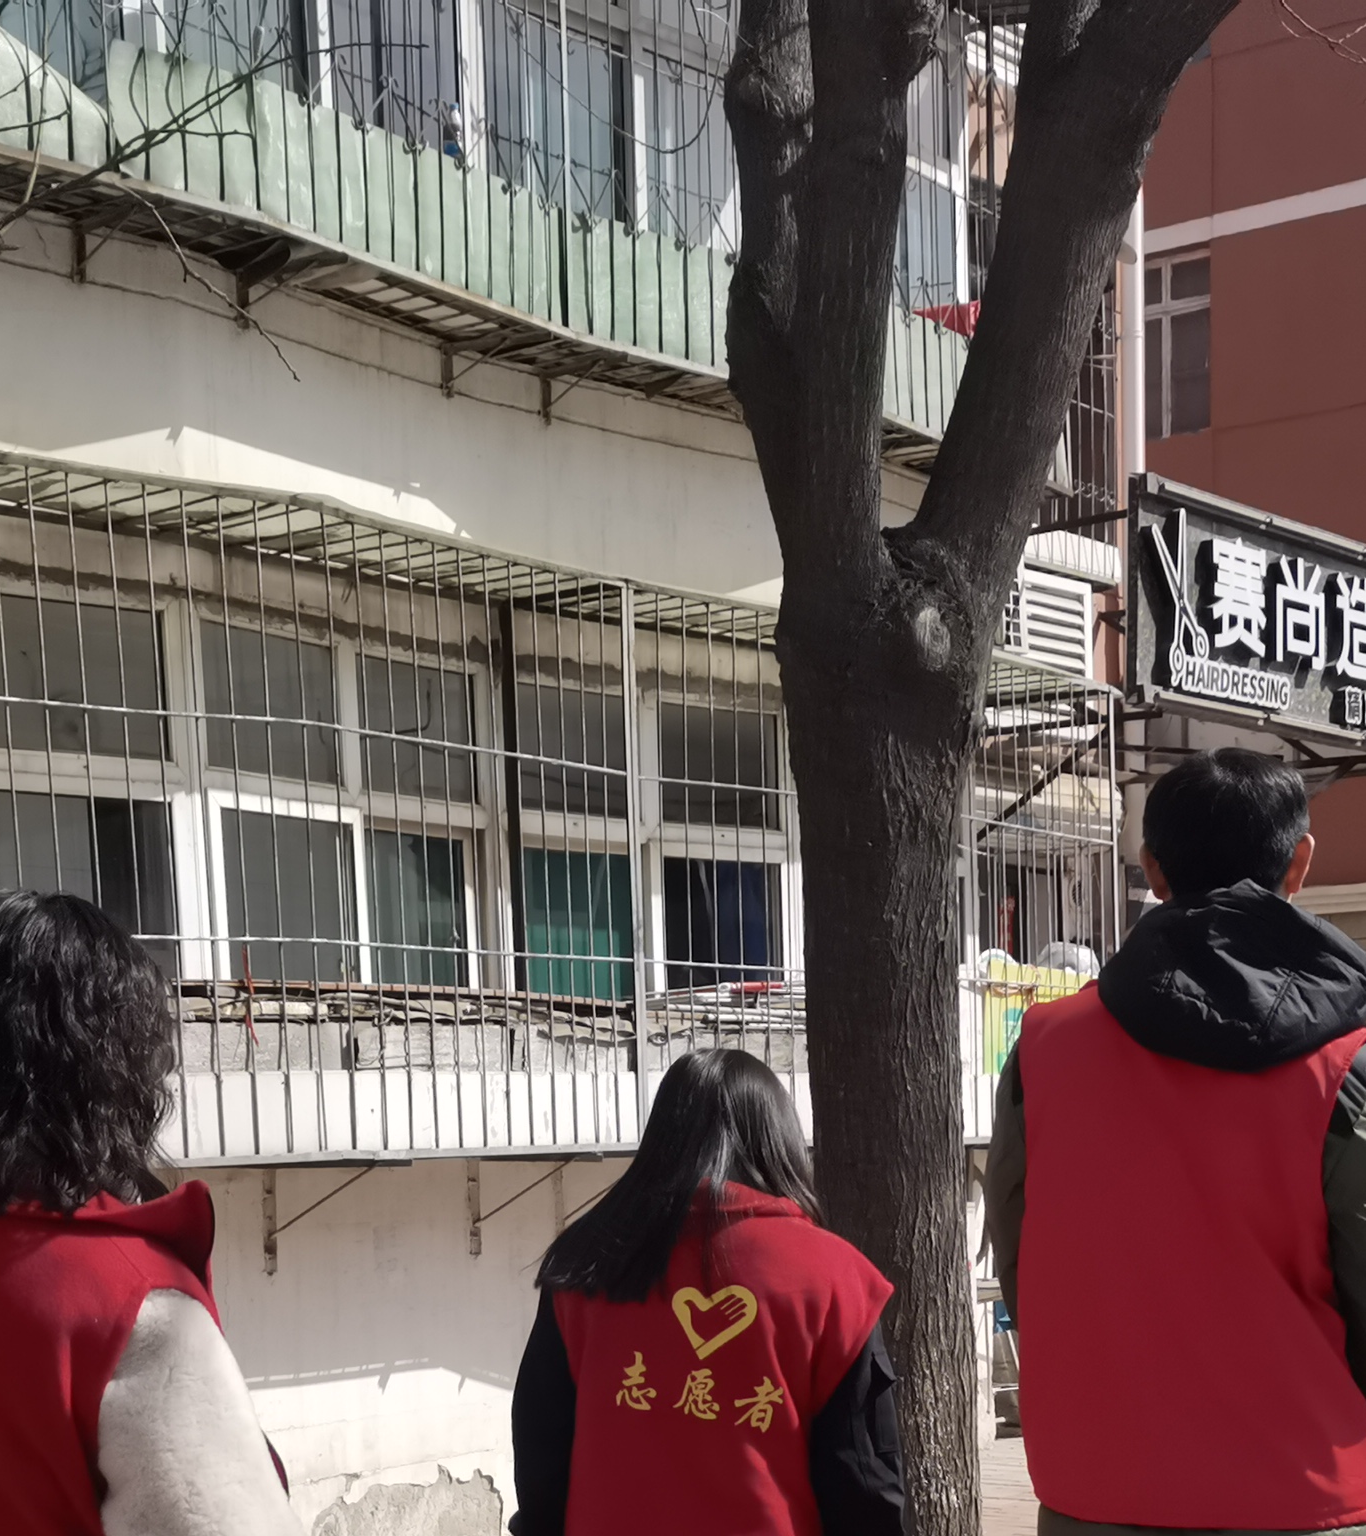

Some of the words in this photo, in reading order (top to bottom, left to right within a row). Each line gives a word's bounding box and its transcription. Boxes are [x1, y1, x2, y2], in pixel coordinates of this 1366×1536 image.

[1185, 661, 1290, 709] HAIRDRESSING
[615, 1350, 784, 1433] 志愿者
